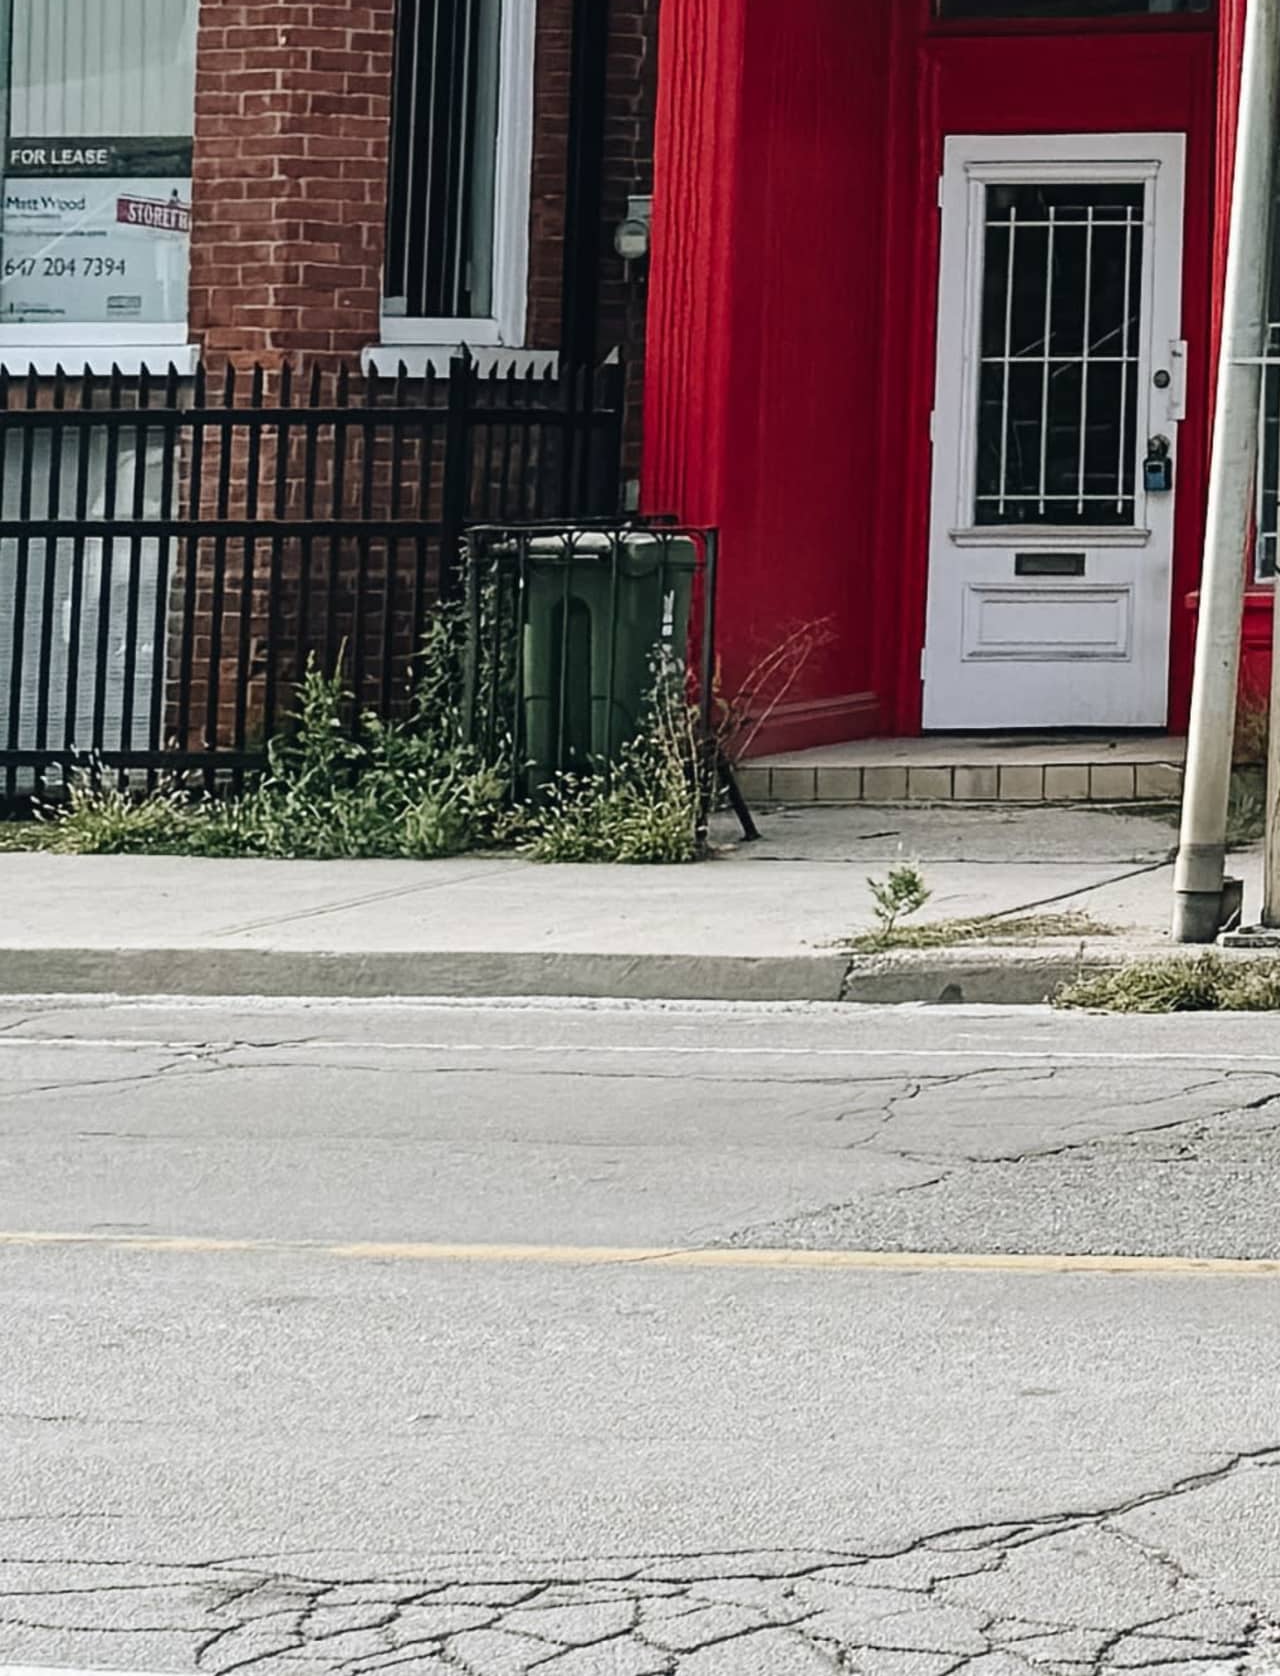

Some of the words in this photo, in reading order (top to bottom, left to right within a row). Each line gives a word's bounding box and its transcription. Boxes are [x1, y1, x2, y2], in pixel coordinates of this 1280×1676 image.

[10, 149, 47, 166] FOR
[51, 149, 108, 166] LEASE
[4, 257, 36, 277] 647
[43, 257, 76, 277] 204
[83, 257, 125, 277] 7394
